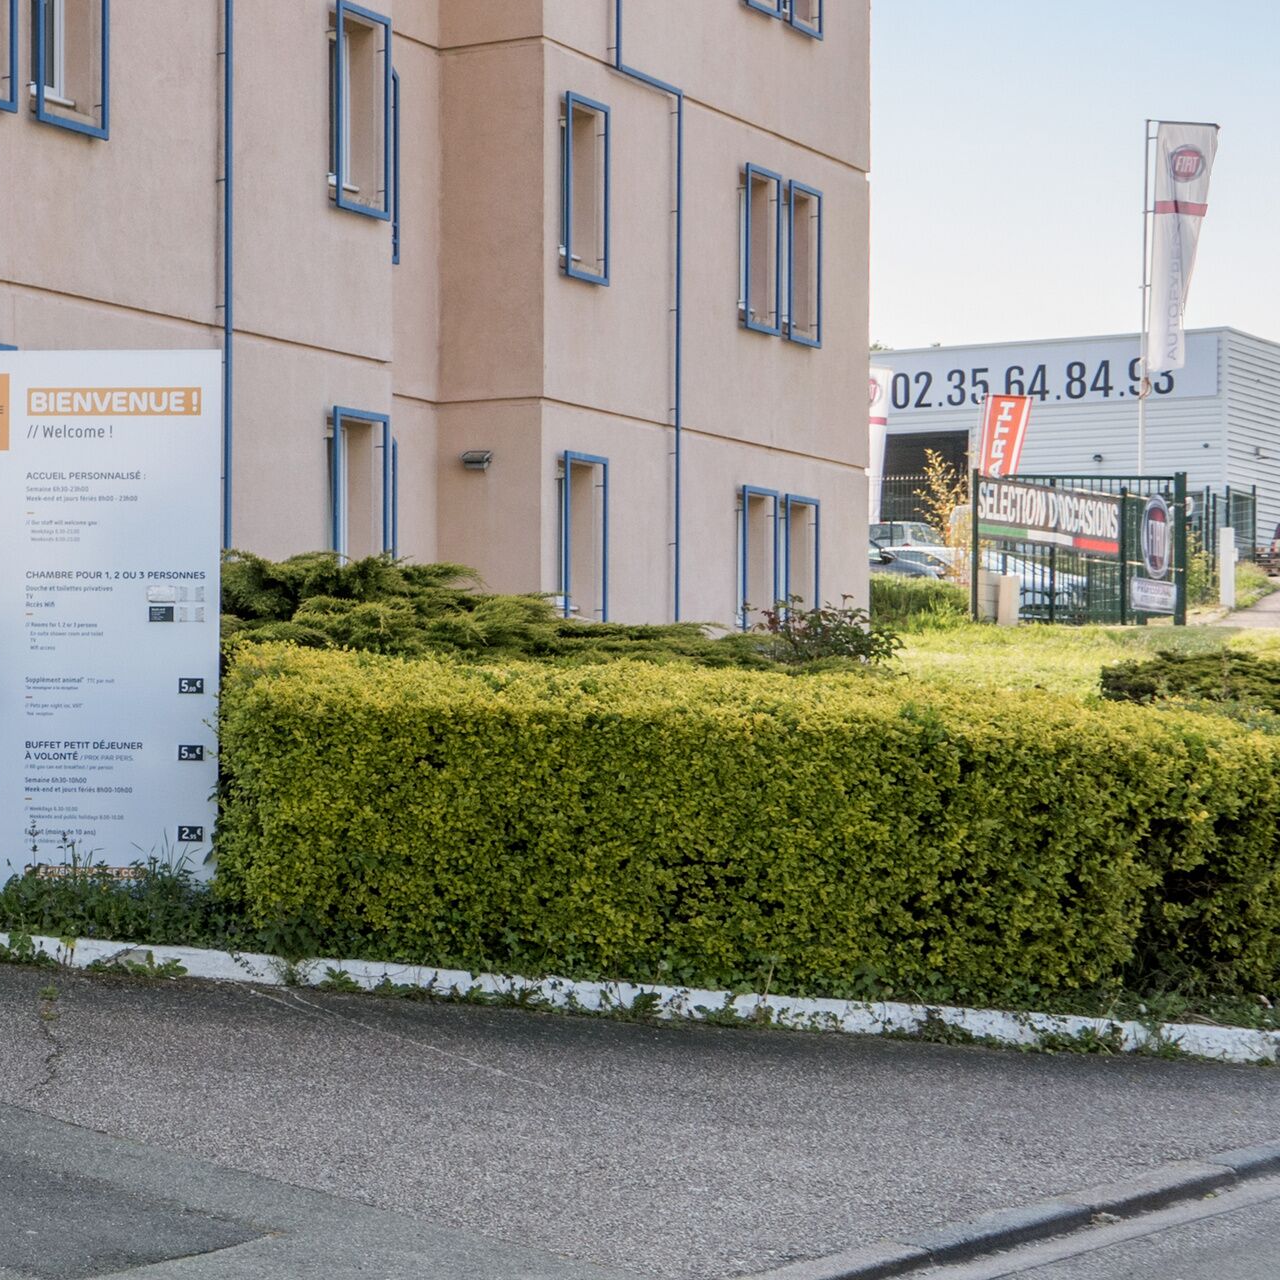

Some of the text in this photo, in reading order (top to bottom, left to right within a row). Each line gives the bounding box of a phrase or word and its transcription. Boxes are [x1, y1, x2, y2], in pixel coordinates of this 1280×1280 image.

[1176, 156, 1198, 172] FIAT
[30, 391, 198, 413] BIENVENUE !
[43, 425, 105, 438] Welcome
[109, 425, 113, 438] !
[989, 401, 1016, 478] ARTH
[26, 472, 66, 480] ACCUEIL
[69, 470, 141, 480] PERSONNALISÉ
[63, 495, 79, 503] jours
[978, 481, 1119, 539] SELECTION D'OCCASIONS
[26, 571, 206, 580] CHAMBRE POUR 1, 2 OU 3 PERSONNES
[83, 585, 113, 593] privatives
[25, 739, 143, 750] BUFFET PETIT DÉJEUNER
[25, 751, 32, 760] À
[34, 751, 78, 760] VOLONTÉ
